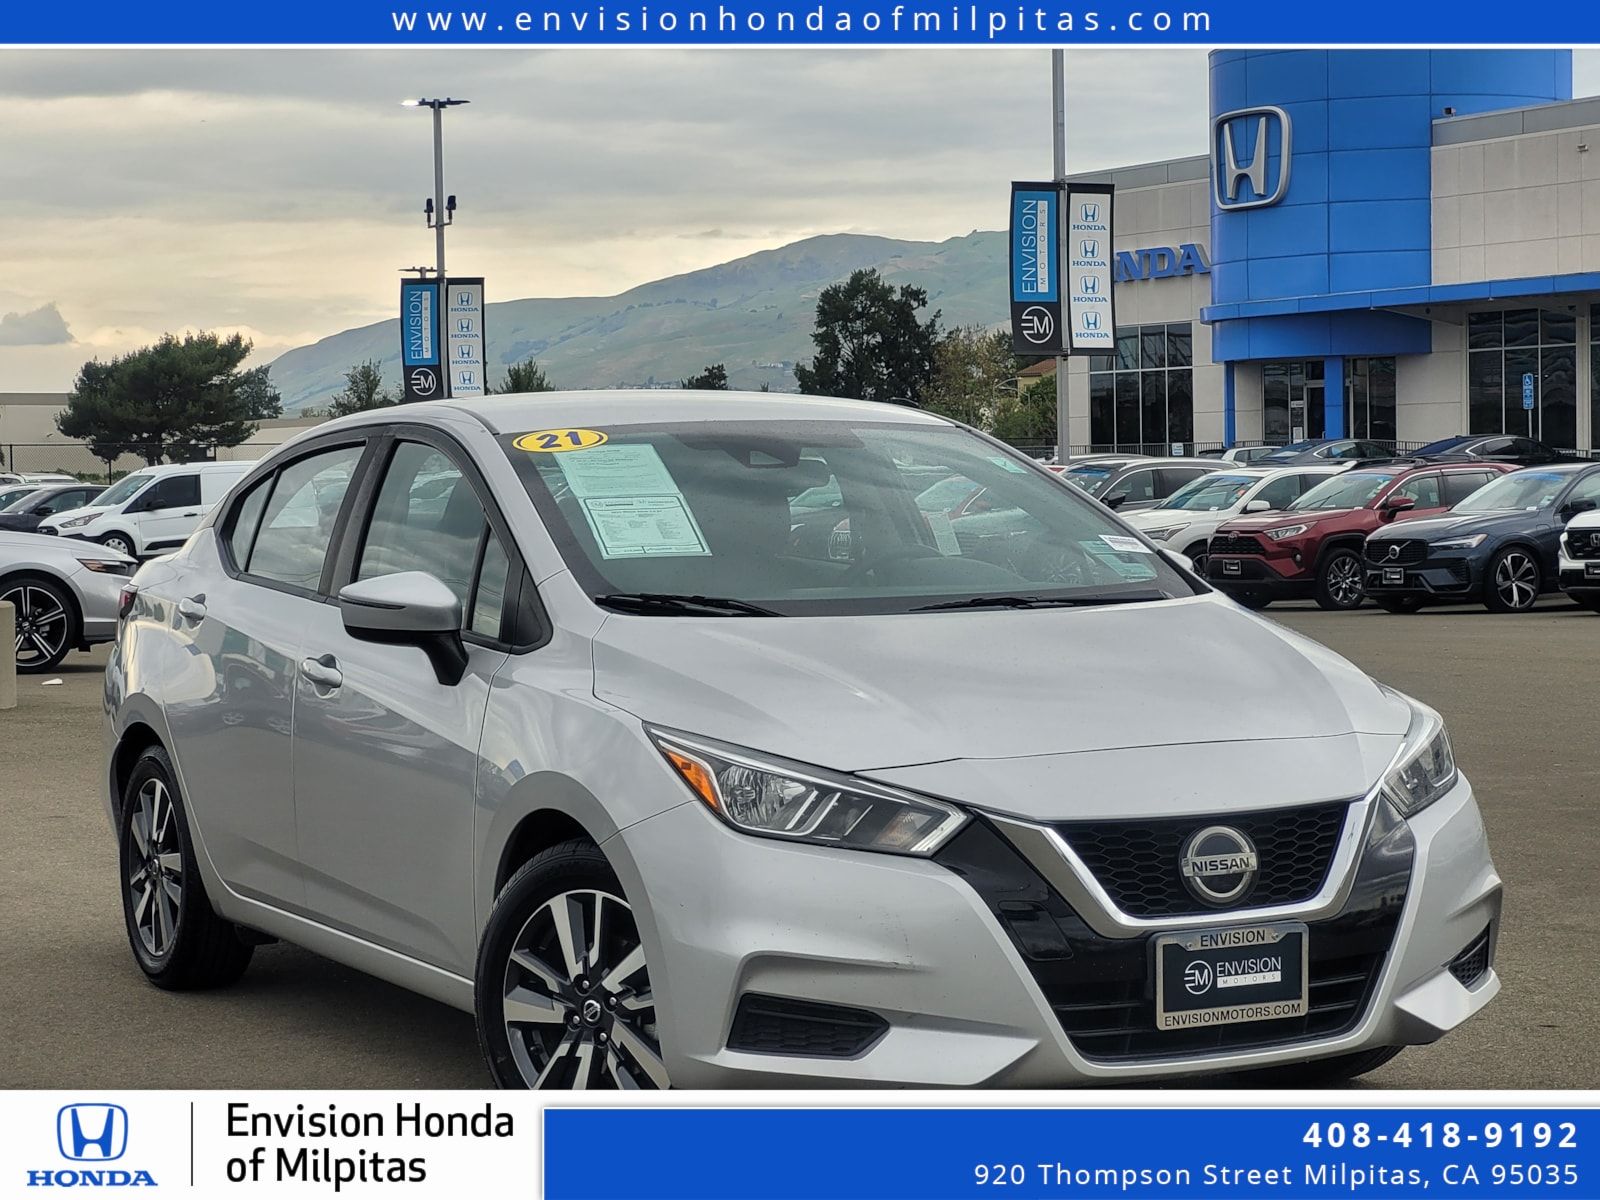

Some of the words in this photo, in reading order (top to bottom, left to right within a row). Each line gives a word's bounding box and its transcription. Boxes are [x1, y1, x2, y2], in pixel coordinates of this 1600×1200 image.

[1022, 199, 1037, 294] ENVISION
[1114, 244, 1211, 283] NDA
[410, 291, 422, 360] ENVISION
[536, 431, 583, 449] 21
[1191, 857, 1250, 873] NISSAN
[1200, 930, 1266, 947] ENVISION
[1216, 956, 1282, 977] ENVISION
[1222, 974, 1276, 985] MOTORS
[1164, 1003, 1301, 1027] ENVISIONMOTORS.COM
